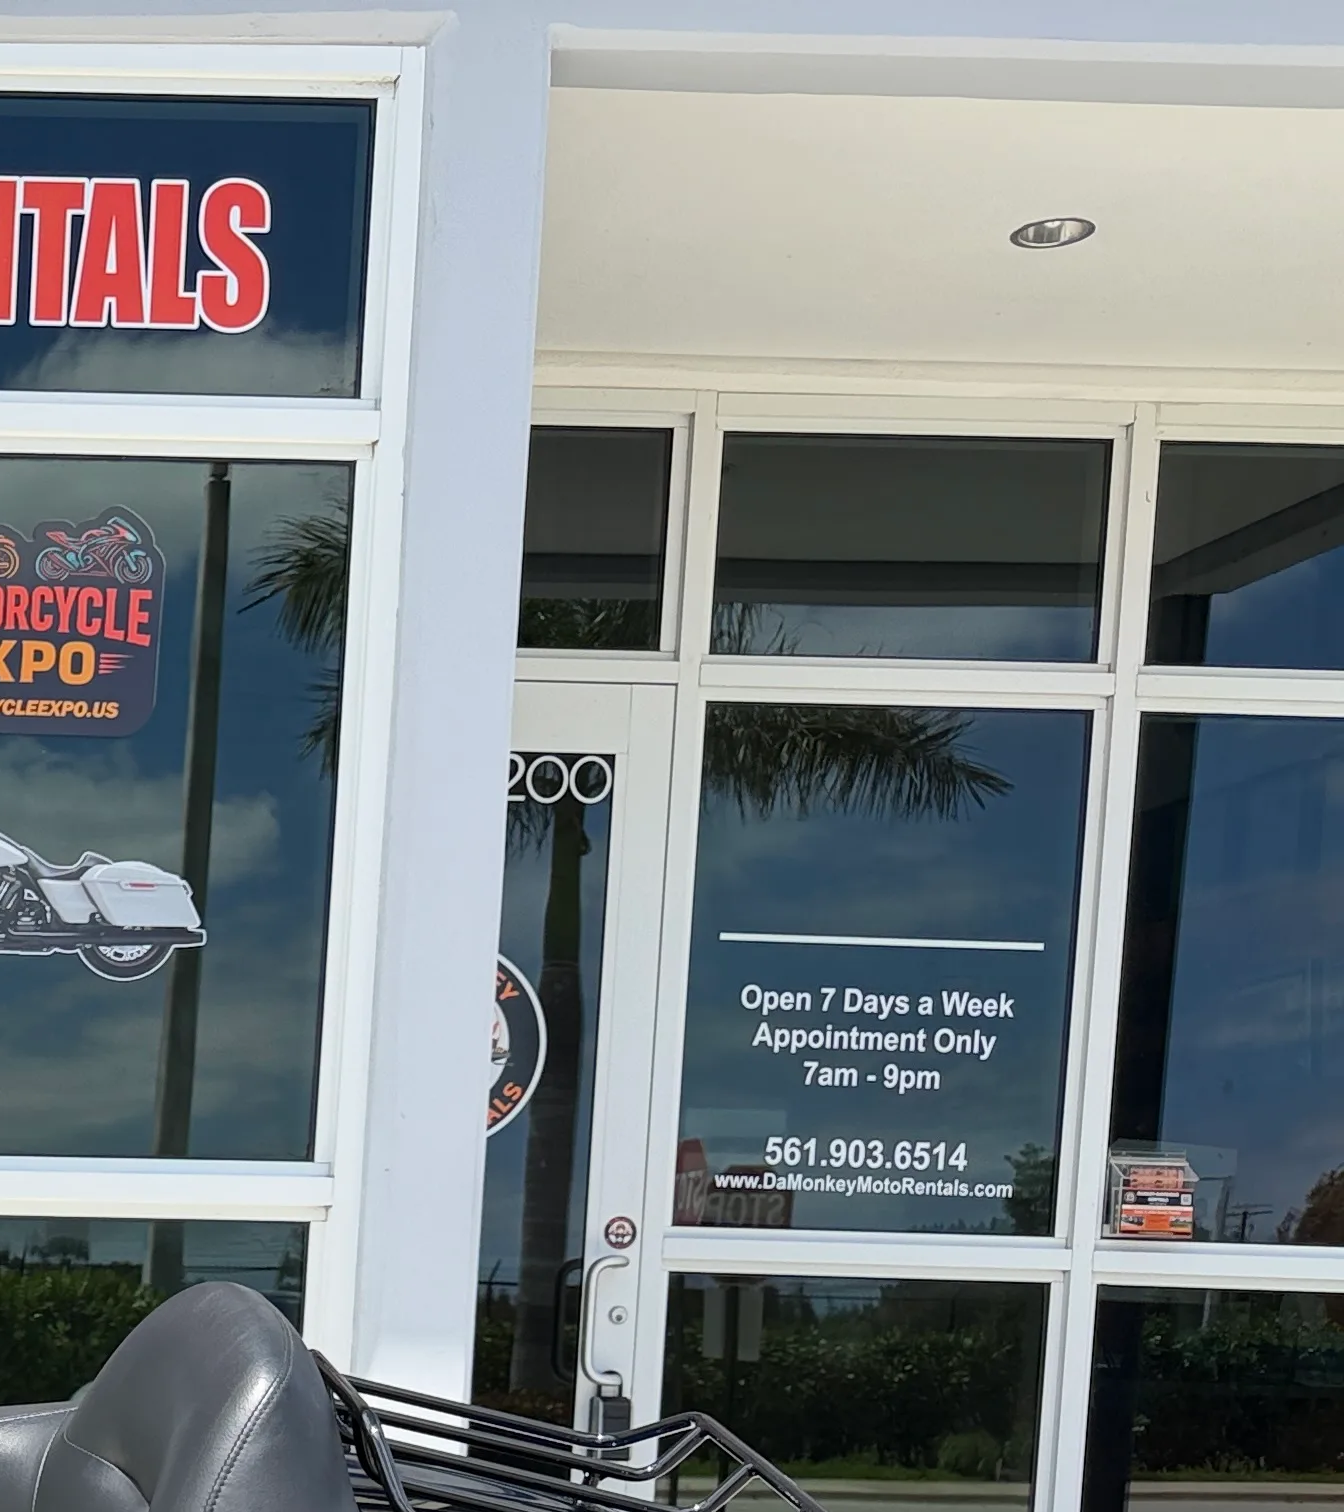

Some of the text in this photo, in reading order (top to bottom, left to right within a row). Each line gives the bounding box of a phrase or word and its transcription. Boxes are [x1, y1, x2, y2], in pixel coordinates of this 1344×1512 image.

[740, 984, 1015, 1020] Open 7 Days a Week
[752, 1022, 997, 1061] Appointment Only
[803, 1061, 858, 1087] 7am
[883, 1063, 941, 1095] 9pm
[764, 1136, 968, 1172] 561.903.6514
[714, 1172, 1014, 1199] www.DaMonkeyMotoRentals.com
